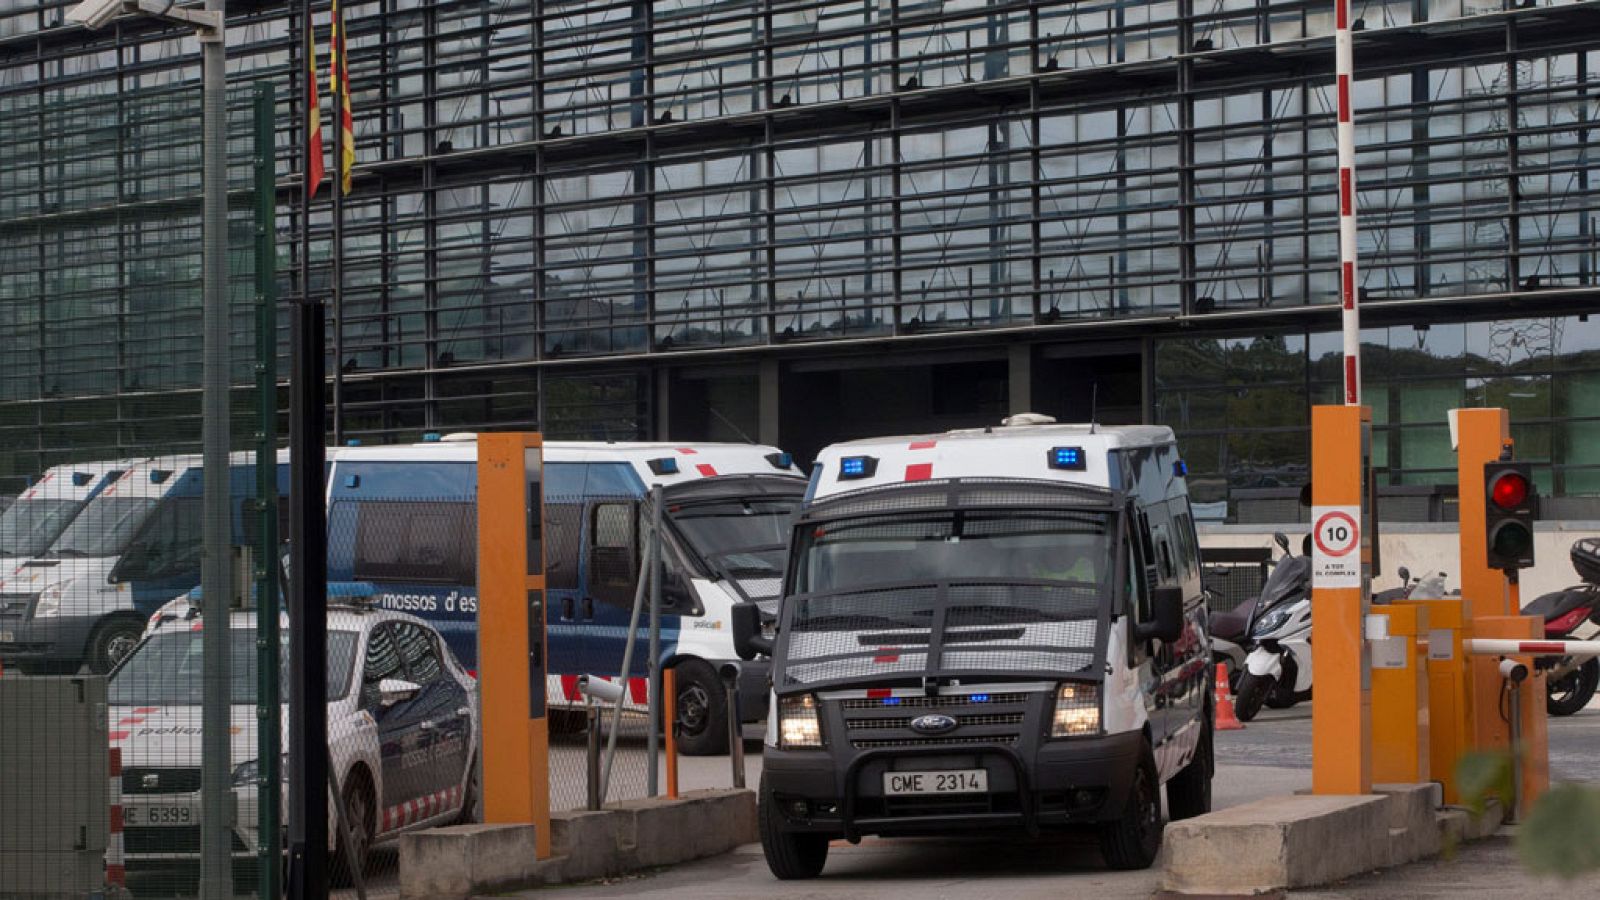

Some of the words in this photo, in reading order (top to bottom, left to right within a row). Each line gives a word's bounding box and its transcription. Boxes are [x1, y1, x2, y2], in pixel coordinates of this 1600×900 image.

[1327, 526, 1348, 541] 10
[382, 593, 437, 611] mossos
[444, 591, 477, 612] d'es
[891, 775, 924, 792] CME
[936, 773, 979, 791] 2314
[124, 807, 138, 823] E
[149, 807, 190, 823] 6399
